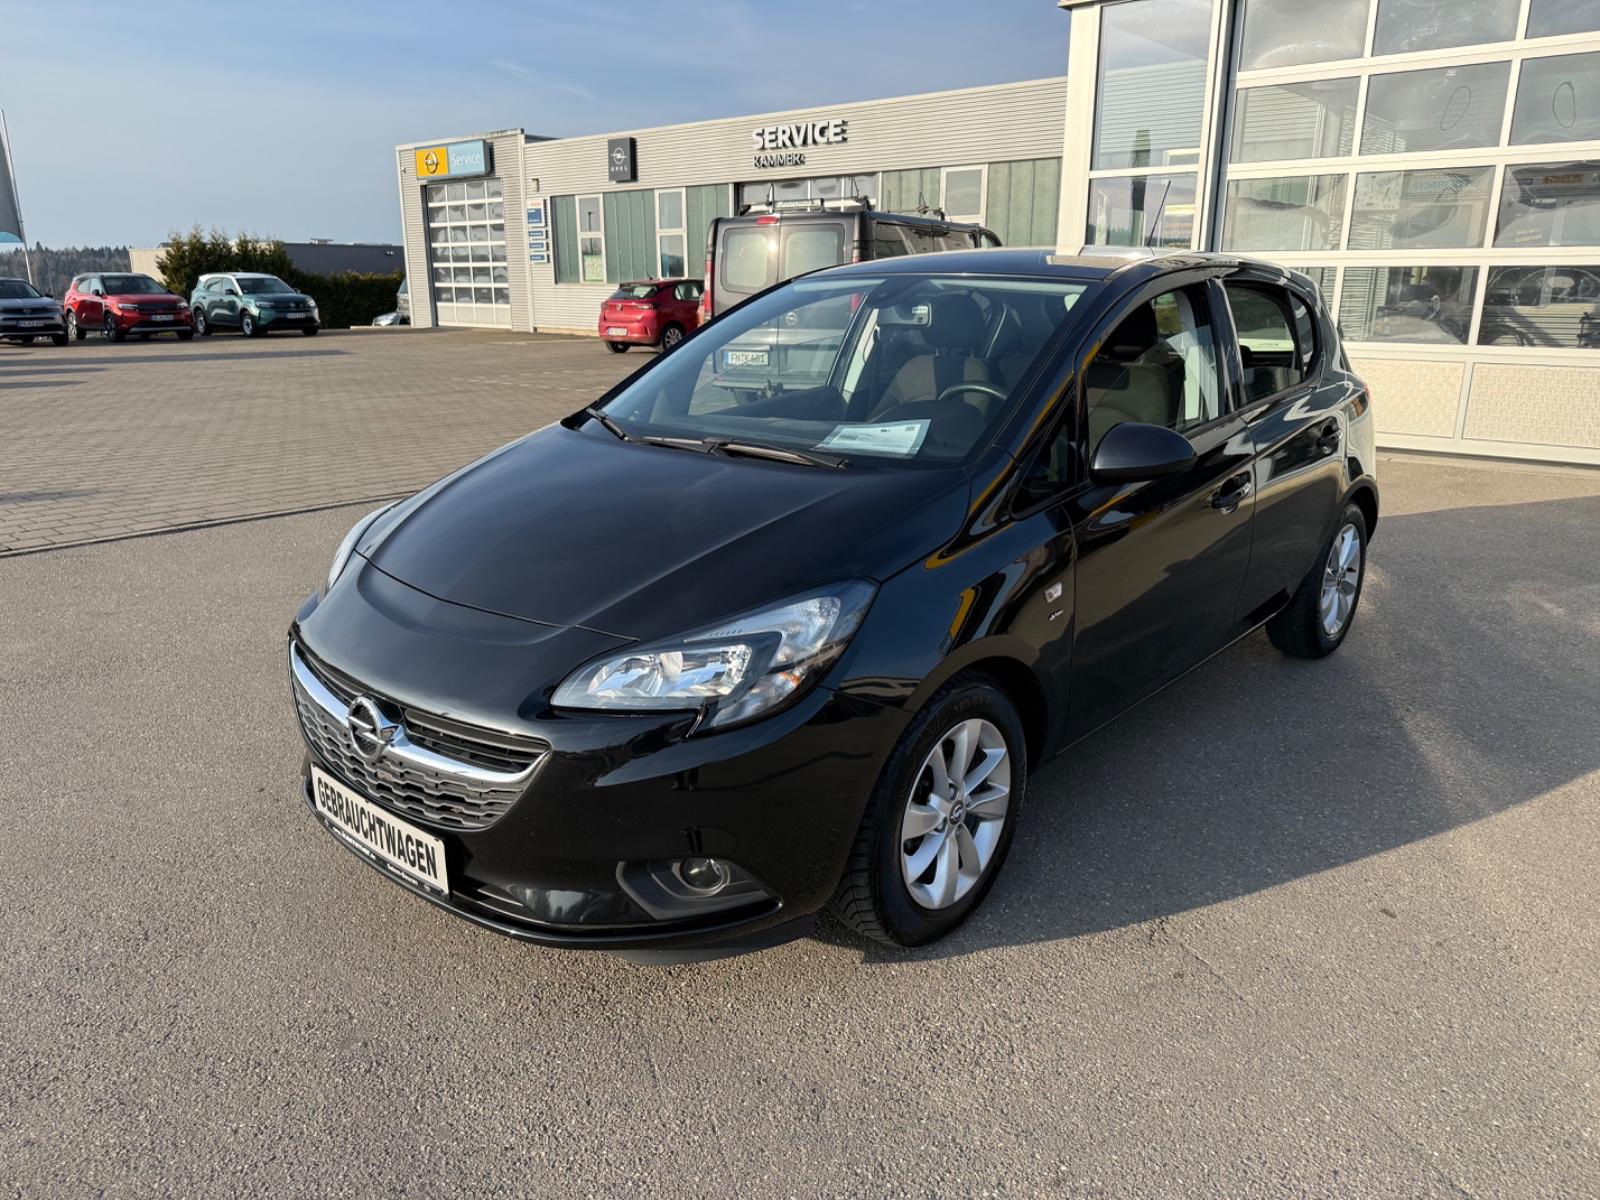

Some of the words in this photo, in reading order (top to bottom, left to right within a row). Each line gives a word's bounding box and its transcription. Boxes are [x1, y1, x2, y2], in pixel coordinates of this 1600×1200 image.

[752, 119, 844, 149] SERVICE
[450, 151, 481, 166] Service
[317, 777, 438, 880] GEBRAUCHTWAGEN
